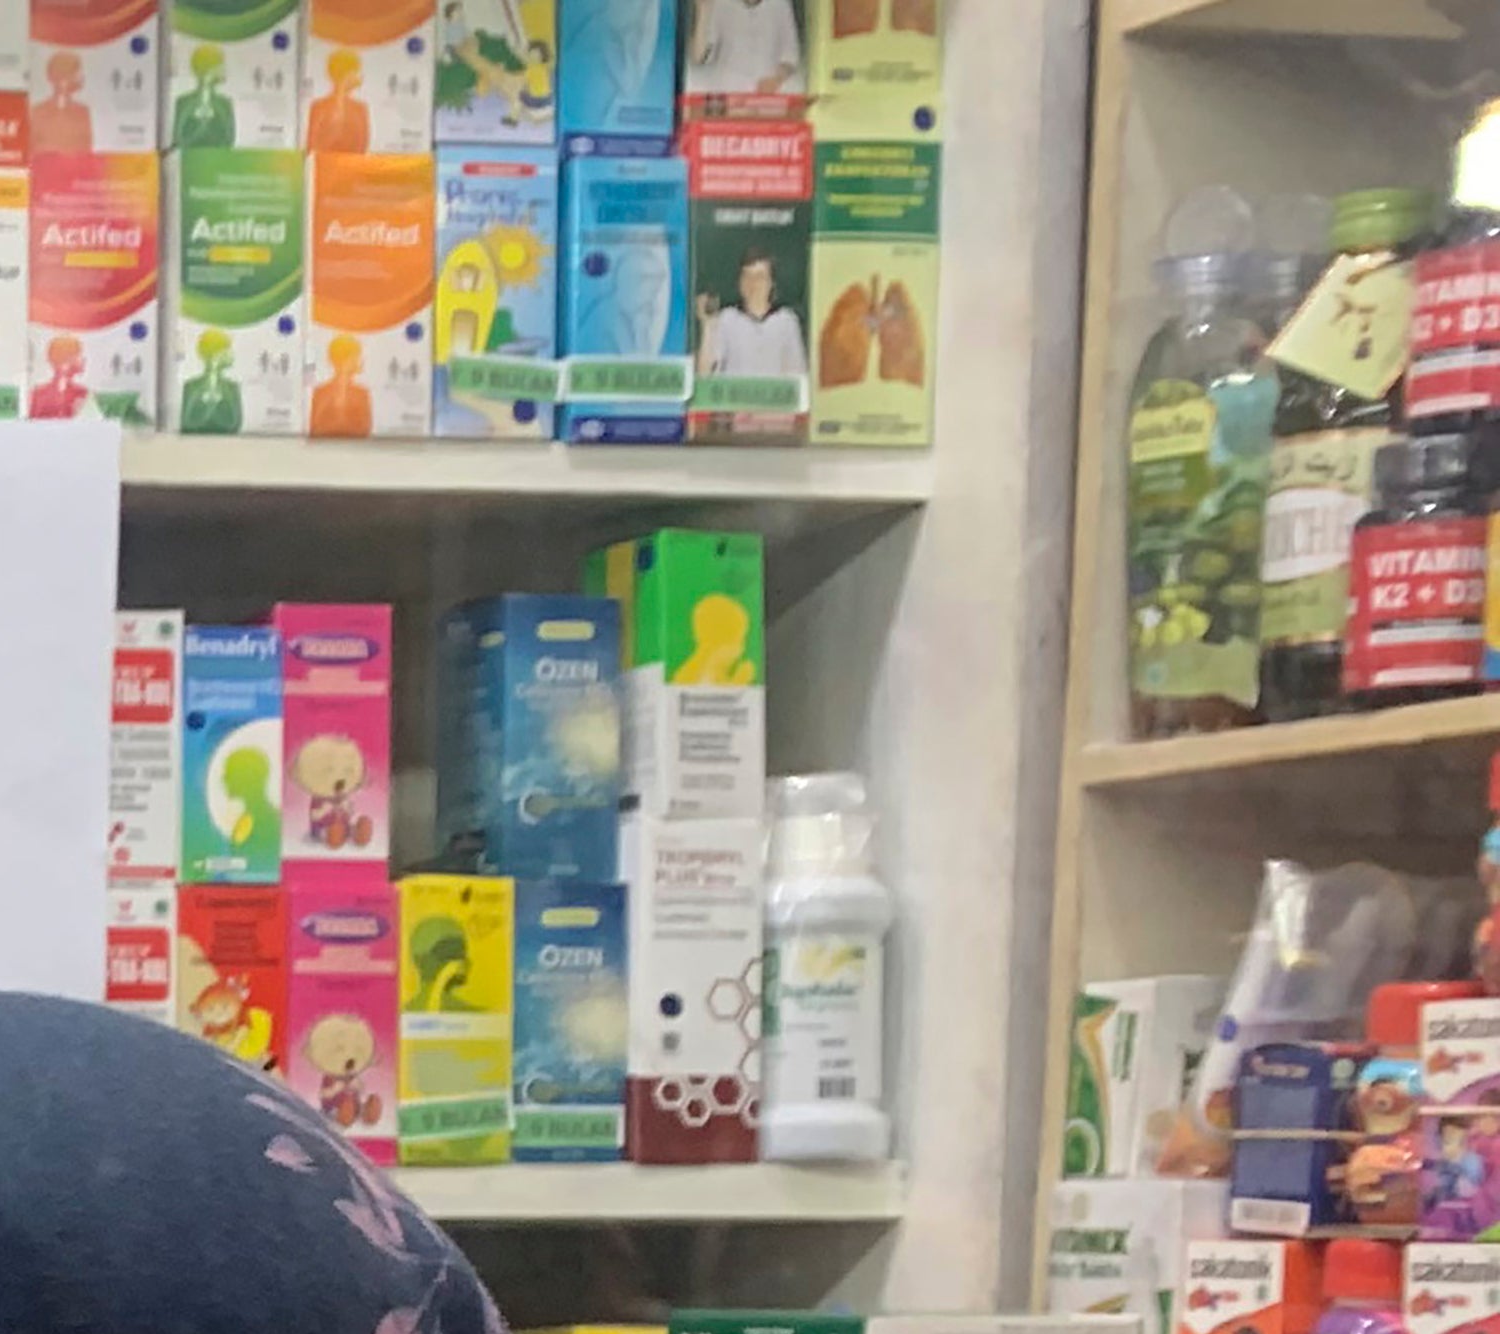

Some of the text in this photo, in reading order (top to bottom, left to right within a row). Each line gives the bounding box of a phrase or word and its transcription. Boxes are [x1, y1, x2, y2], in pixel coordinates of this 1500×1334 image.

[41, 221, 143, 252] Actifed
[191, 217, 287, 246] Actifed
[323, 220, 421, 250] Actifed
[184, 632, 279, 658] Benadryl
